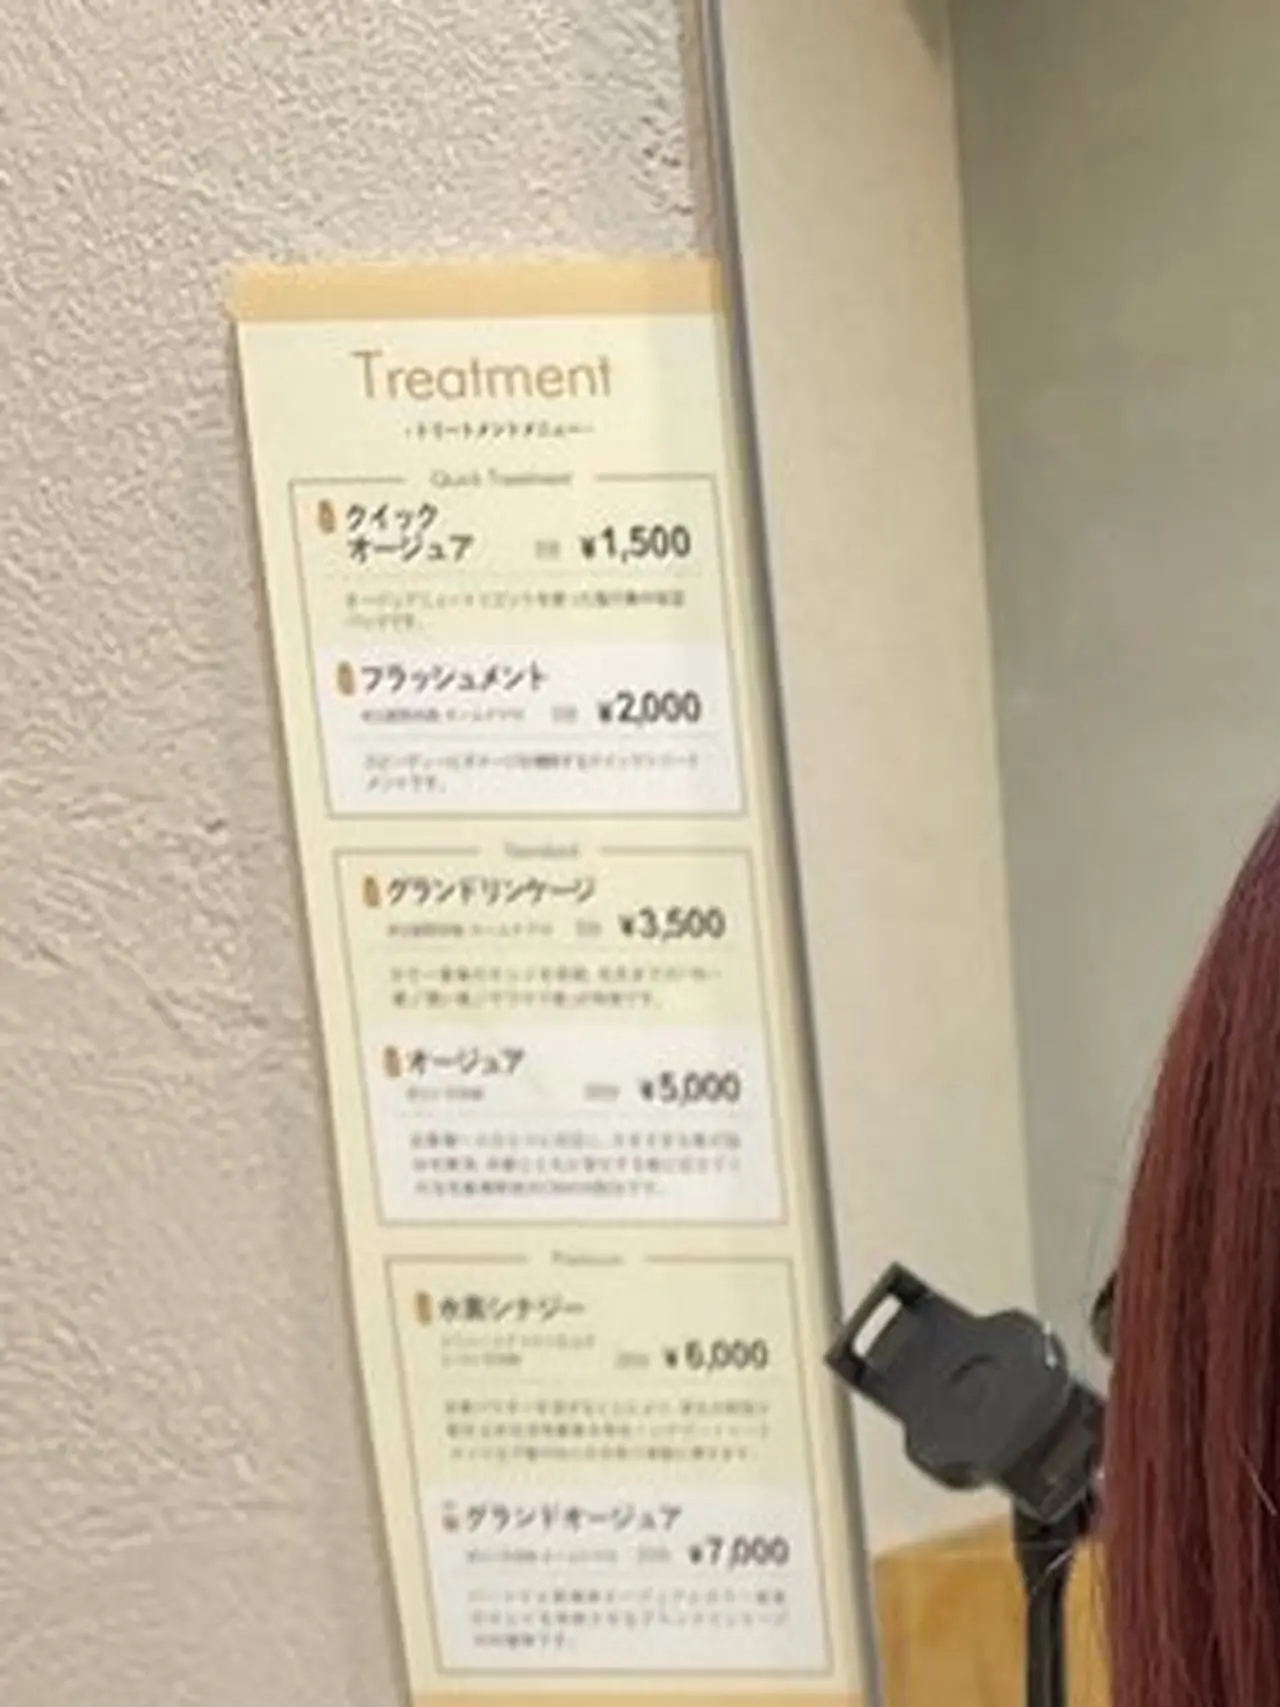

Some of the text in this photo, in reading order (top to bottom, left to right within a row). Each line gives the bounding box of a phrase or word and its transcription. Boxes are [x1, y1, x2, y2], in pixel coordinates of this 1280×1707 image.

[352, 350, 613, 401] Treatment
[346, 502, 438, 531] クイック
[347, 533, 475, 565] オージュア
[580, 525, 692, 564] ¥1,500
[362, 661, 547, 694] フラッシュメント
[598, 690, 702, 728] ¥2,000
[618, 906, 727, 944] ¥3,500
[408, 1047, 526, 1076] オージュア
[640, 1071, 742, 1109] ¥5,000
[689, 1535, 791, 1571] ¥7,000
